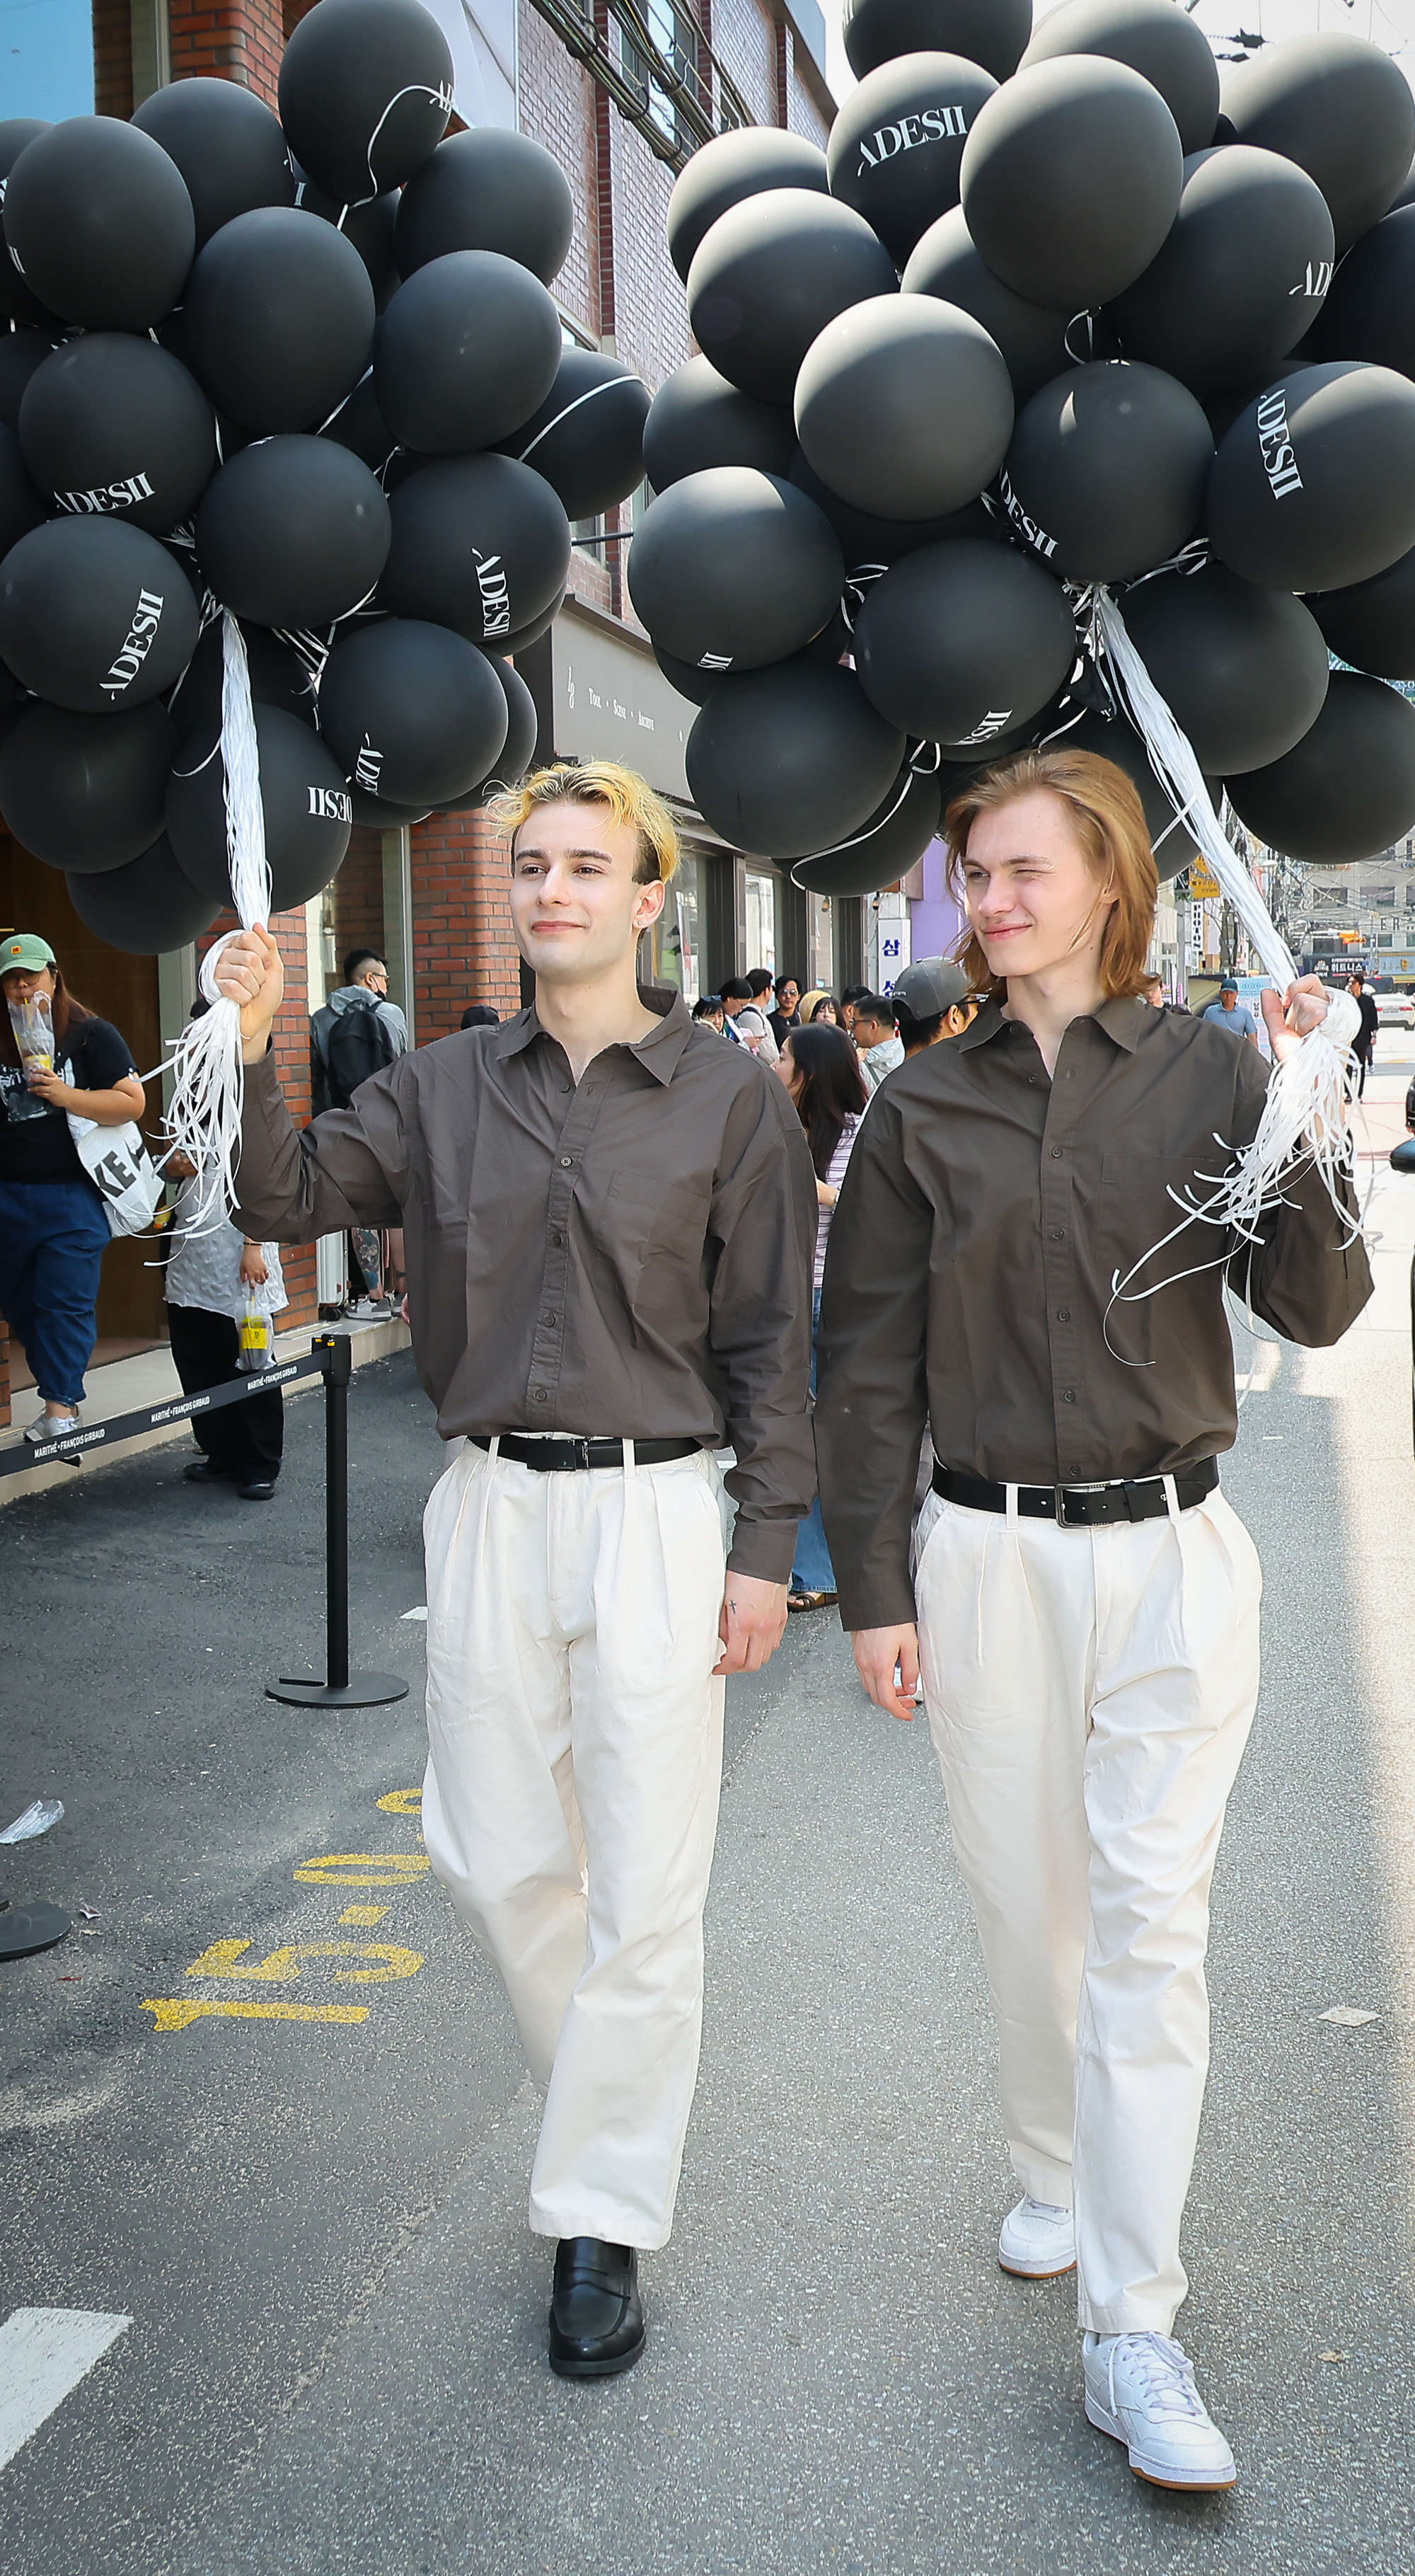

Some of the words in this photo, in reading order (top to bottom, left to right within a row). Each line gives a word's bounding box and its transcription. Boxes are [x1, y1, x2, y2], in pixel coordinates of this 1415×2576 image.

[857, 105, 968, 177] ADESII
[1257, 389, 1304, 500] ADESII
[1000, 468, 1059, 558] DESII
[471, 547, 509, 637] ADESII
[99, 588, 163, 701] ADESII
[307, 786, 352, 824] DESII
[93, 1150, 137, 1199] KE
